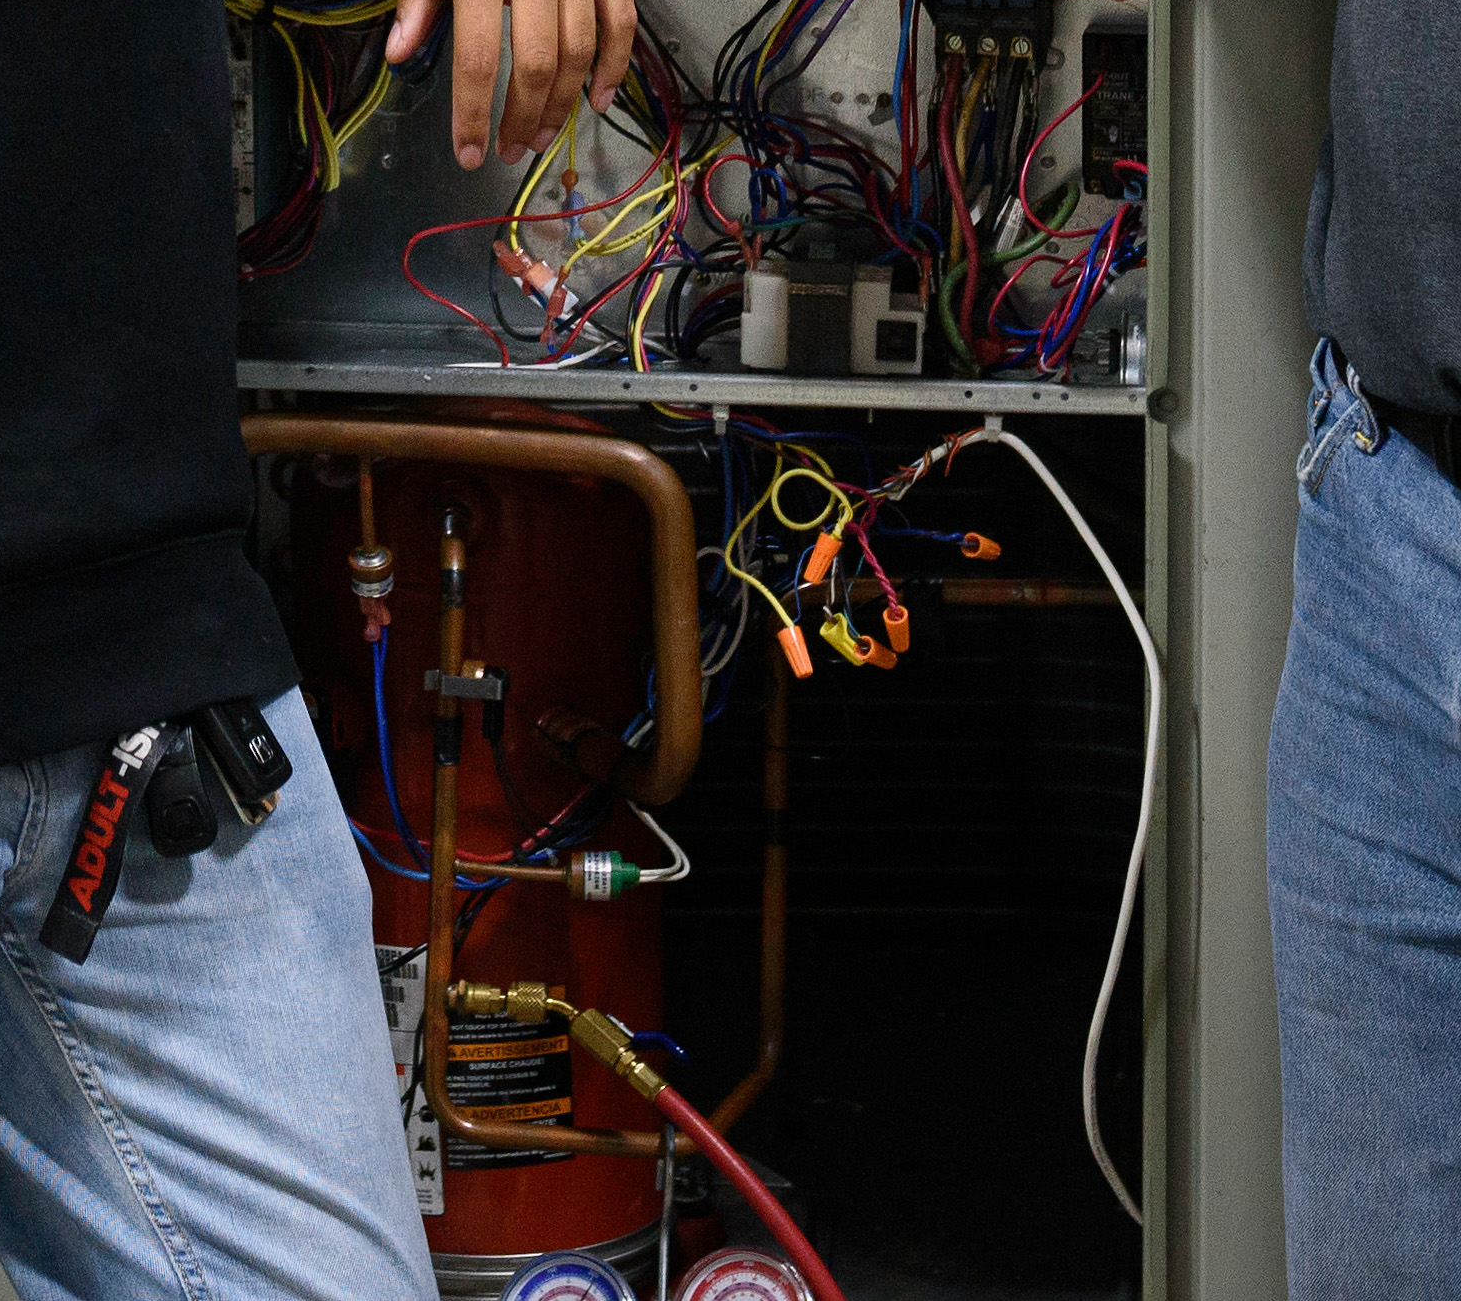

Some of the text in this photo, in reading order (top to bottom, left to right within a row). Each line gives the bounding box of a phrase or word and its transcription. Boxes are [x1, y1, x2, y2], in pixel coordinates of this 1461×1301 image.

[1097, 92, 1136, 101] TRANE
[459, 1038, 564, 1058] AVERTISSEMENT
[469, 1061, 507, 1070] SURFACE
[470, 1103, 562, 1120] ADVERTENCIA
